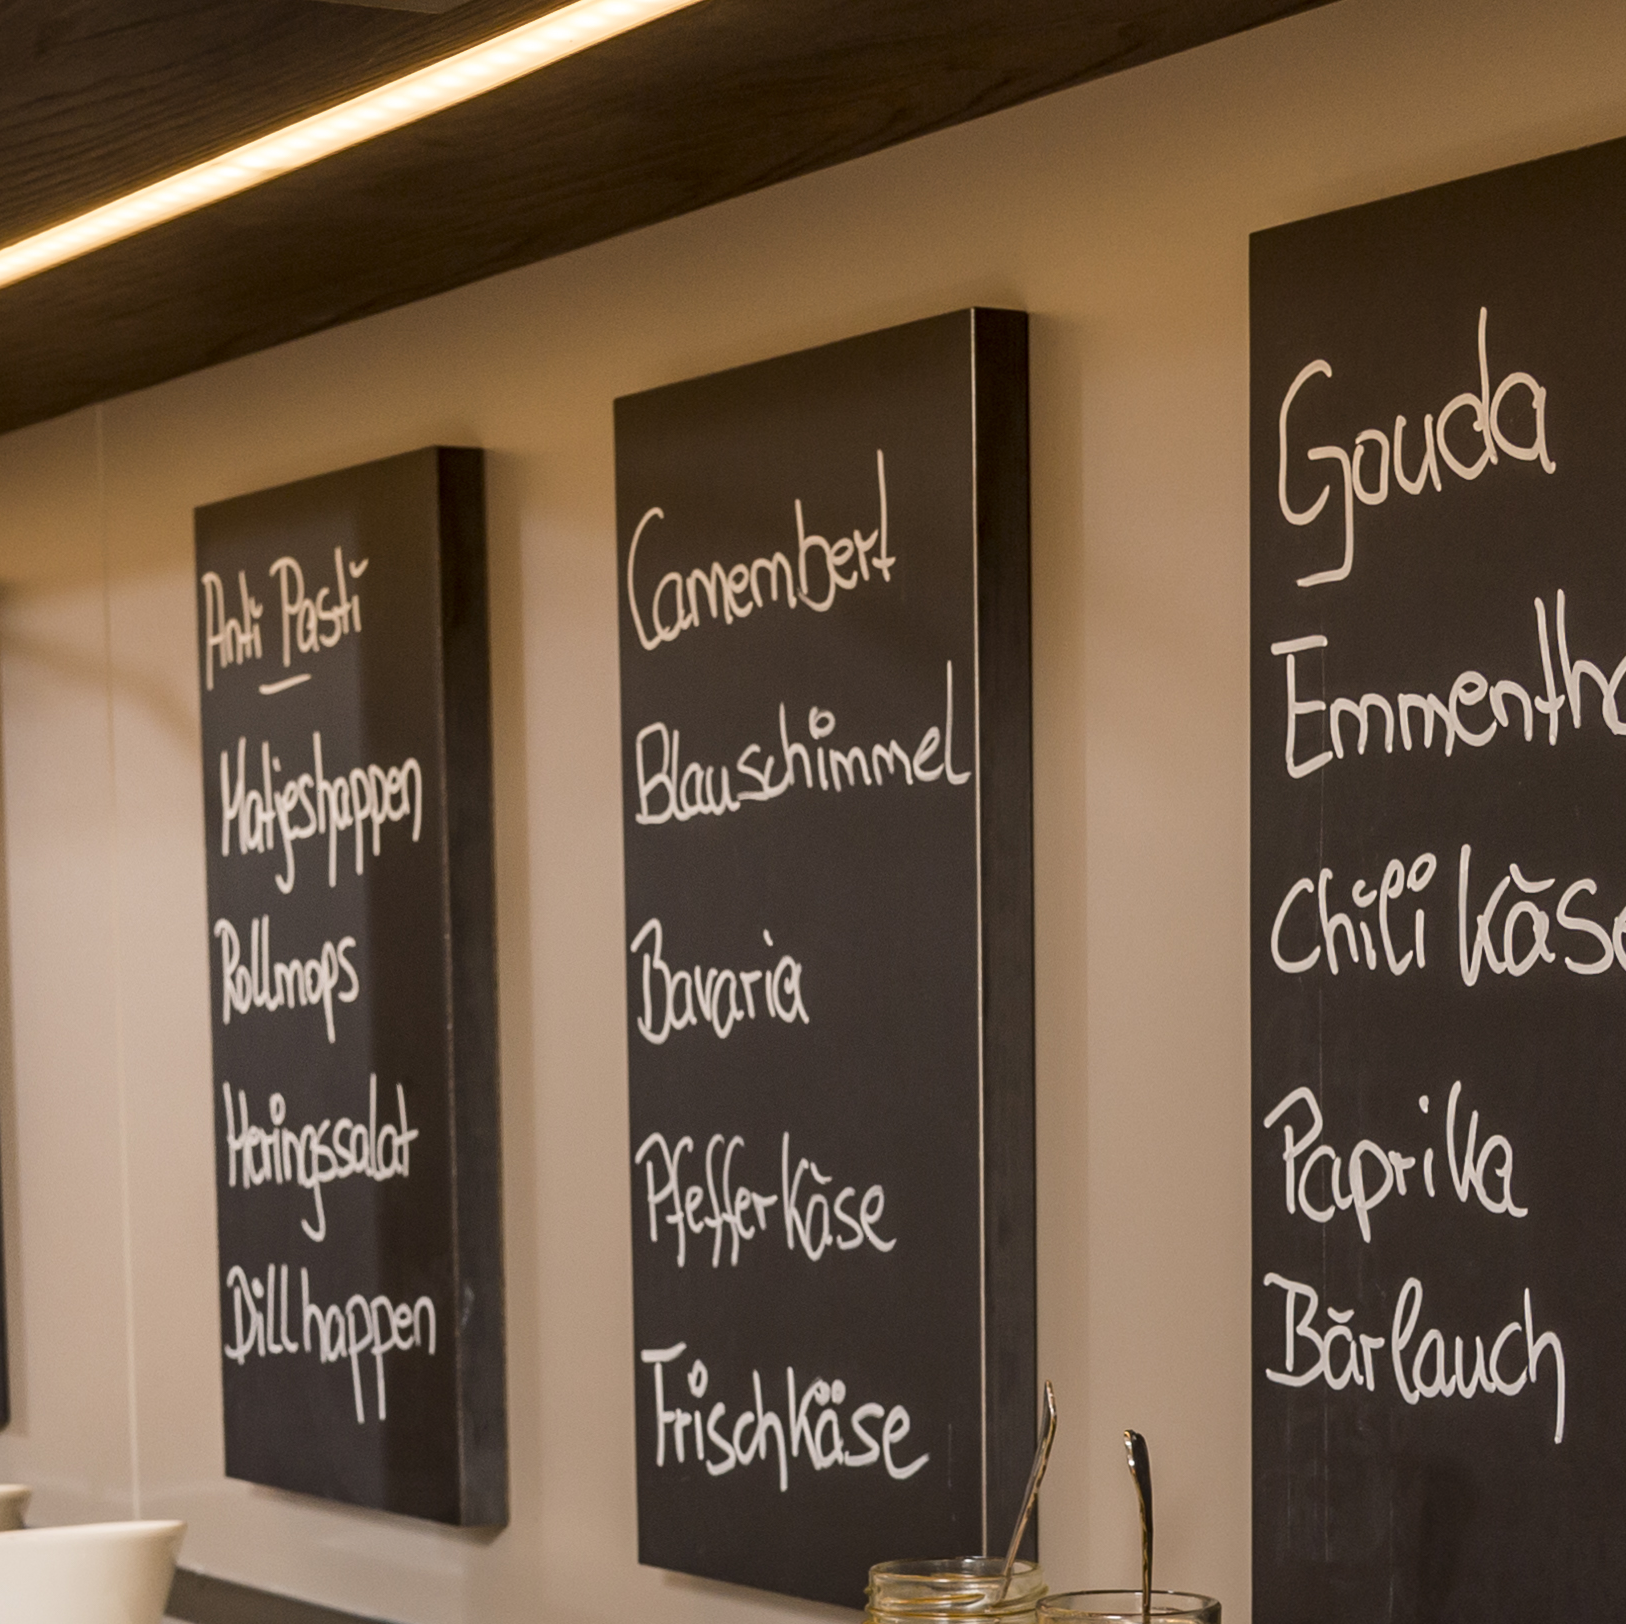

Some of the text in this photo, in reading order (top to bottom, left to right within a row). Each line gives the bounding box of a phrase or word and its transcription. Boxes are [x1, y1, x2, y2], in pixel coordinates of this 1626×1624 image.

[1278, 306, 1557, 587] Gouda
[201, 546, 370, 690] Anti Pasti
[627, 449, 897, 650] Camembert
[220, 730, 422, 895] Matjeshappen
[635, 660, 971, 824] Blauschimmel
[214, 916, 360, 1042] Rollmops
[631, 917, 810, 1043] Bavaria
[1271, 852, 1437, 976] Chili
[222, 1072, 419, 1242] Heringssalat
[1264, 1080, 1529, 1244] Paprika
[642, 1342, 929, 1490] Frischkäse
[1263, 1272, 1565, 1445] Bärlauch
